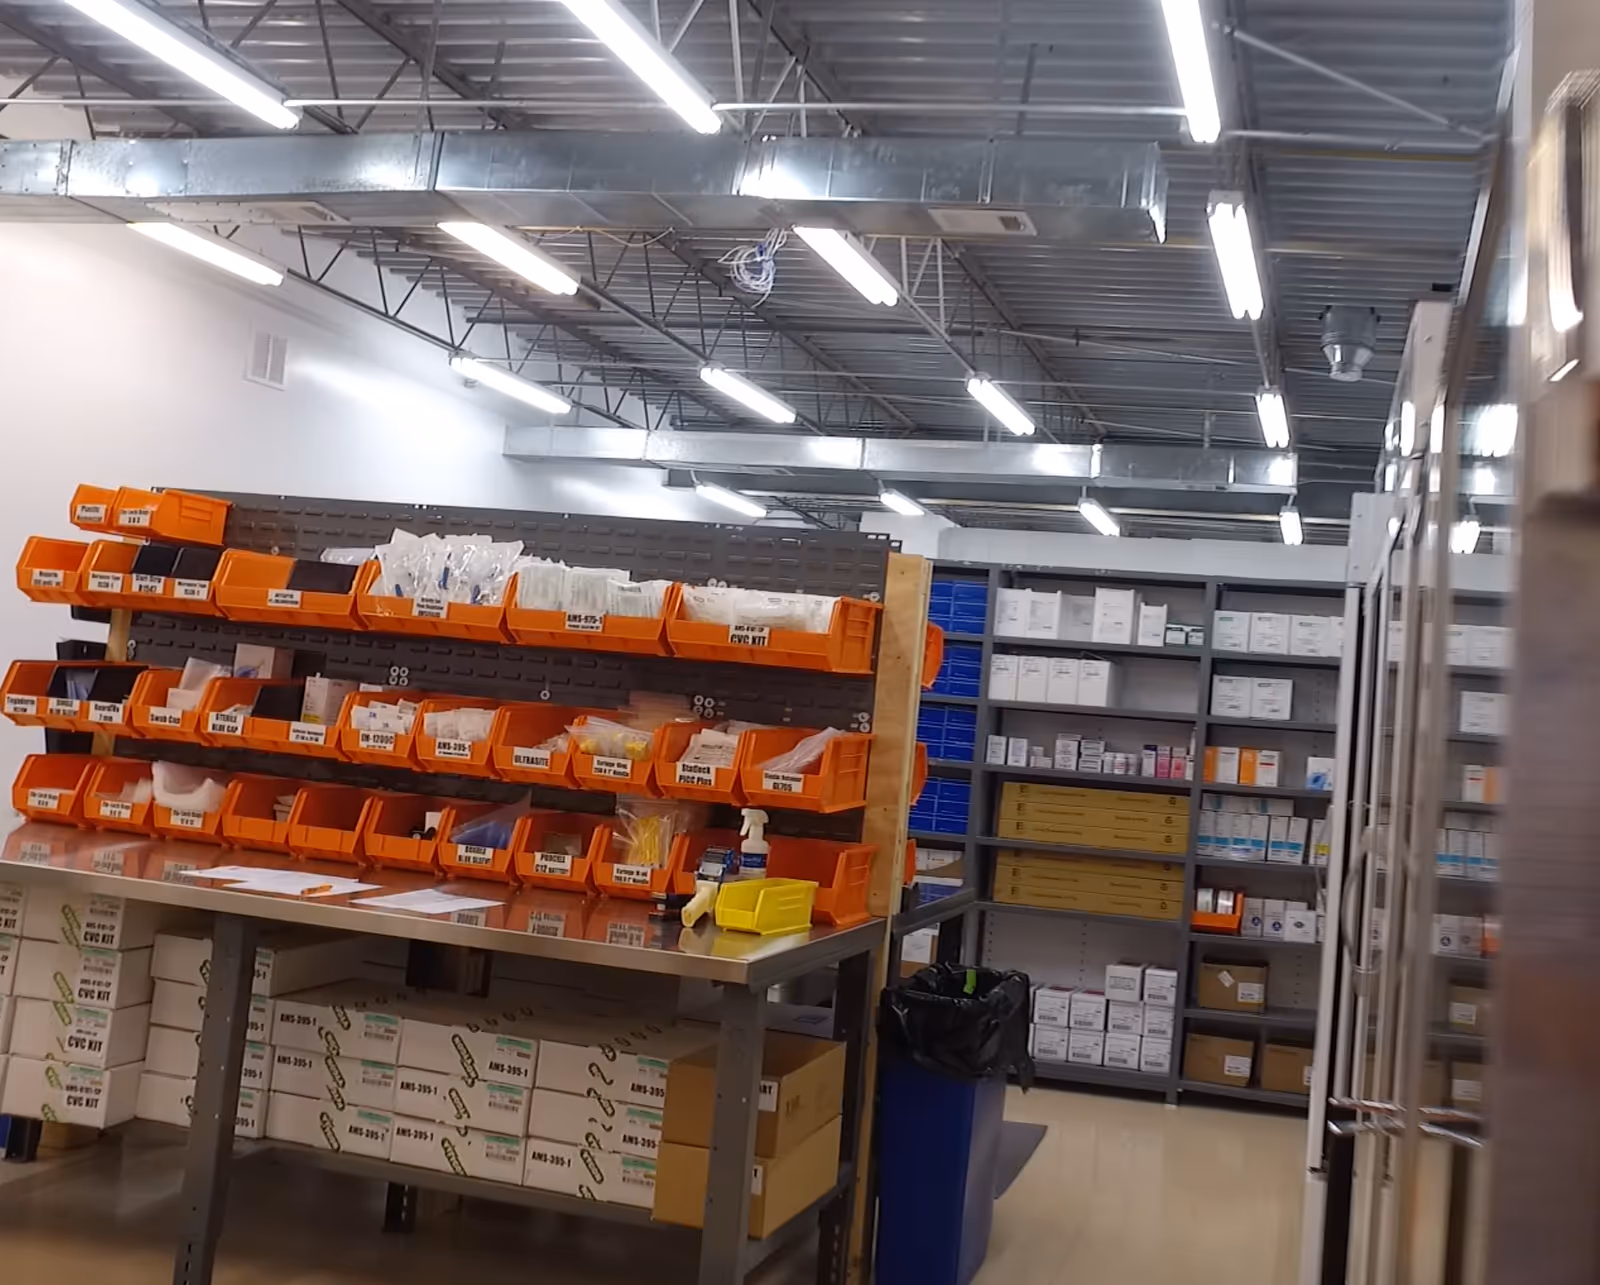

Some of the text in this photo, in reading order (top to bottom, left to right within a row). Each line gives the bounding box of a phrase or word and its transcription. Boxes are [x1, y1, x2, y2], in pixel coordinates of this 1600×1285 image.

[730, 634, 767, 646] CVC KIT
[682, 764, 711, 774] StatLock
[678, 775, 713, 786] PICC Plus
[83, 931, 115, 945] CVC KIT
[78, 987, 111, 1002] CVC KIT
[67, 1035, 103, 1053] CVC KIT
[488, 1061, 529, 1078] AMS-395-1
[630, 1083, 665, 1098] AMS-395
[66, 1095, 99, 1109] CVC KIT
[622, 1134, 659, 1149] AMS-395-
